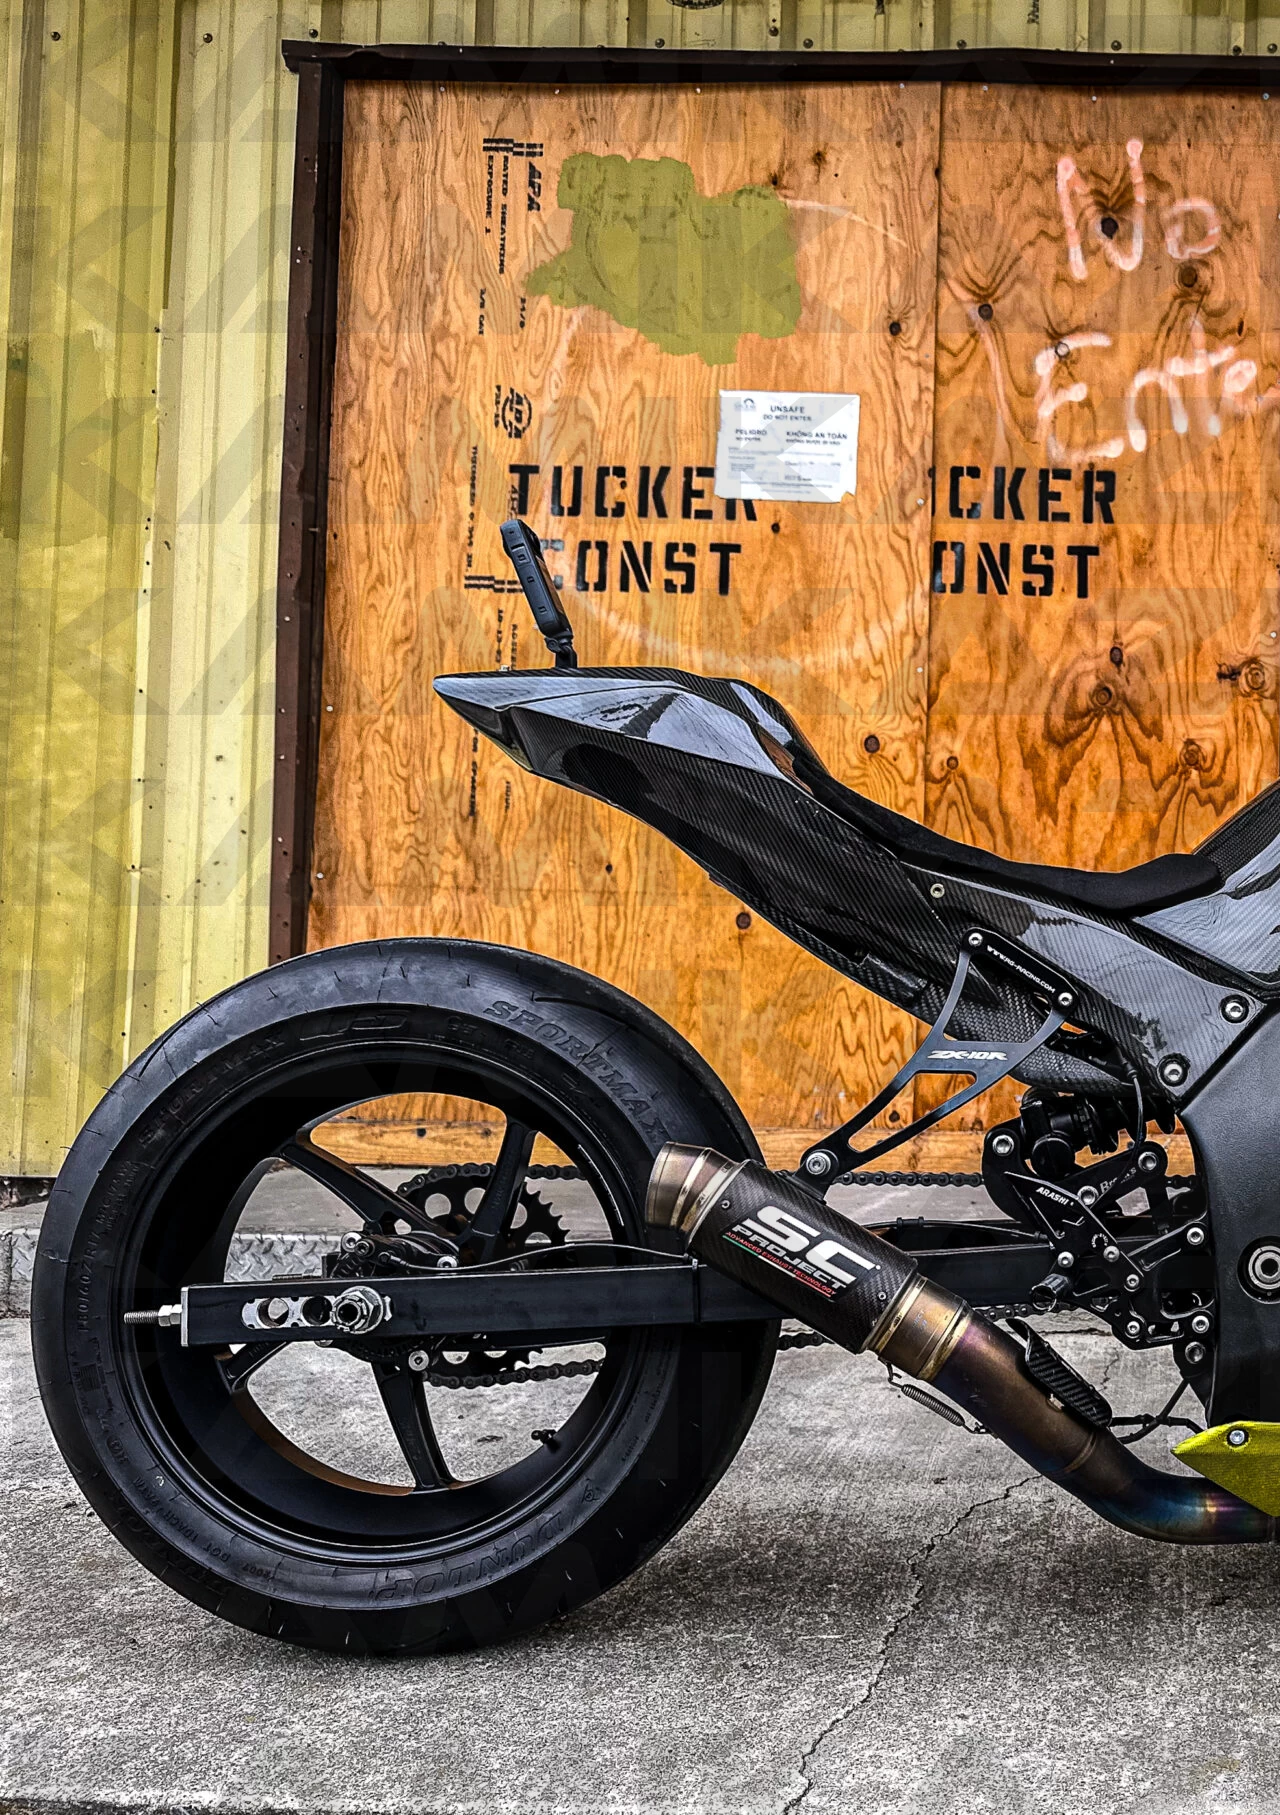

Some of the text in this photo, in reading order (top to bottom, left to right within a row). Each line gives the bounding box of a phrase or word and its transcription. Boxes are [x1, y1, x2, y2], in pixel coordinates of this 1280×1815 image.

[485, 155, 494, 219] EXPOSURE
[527, 161, 542, 212] APA
[1056, 138, 1222, 281] No
[770, 405, 805, 414] UNSAFE
[931, 465, 1117, 524] CKER
[927, 1050, 1008, 1061] ZX-10R
[1036, 1187, 1070, 1206] ARASHI
[725, 1232, 837, 1295] ADVANCED EXHAUST TECHNOLOGY
[732, 1224, 847, 1290] PROJECT
[741, 1205, 876, 1284] SC
[374, 1510, 566, 1602] DUNLOP
